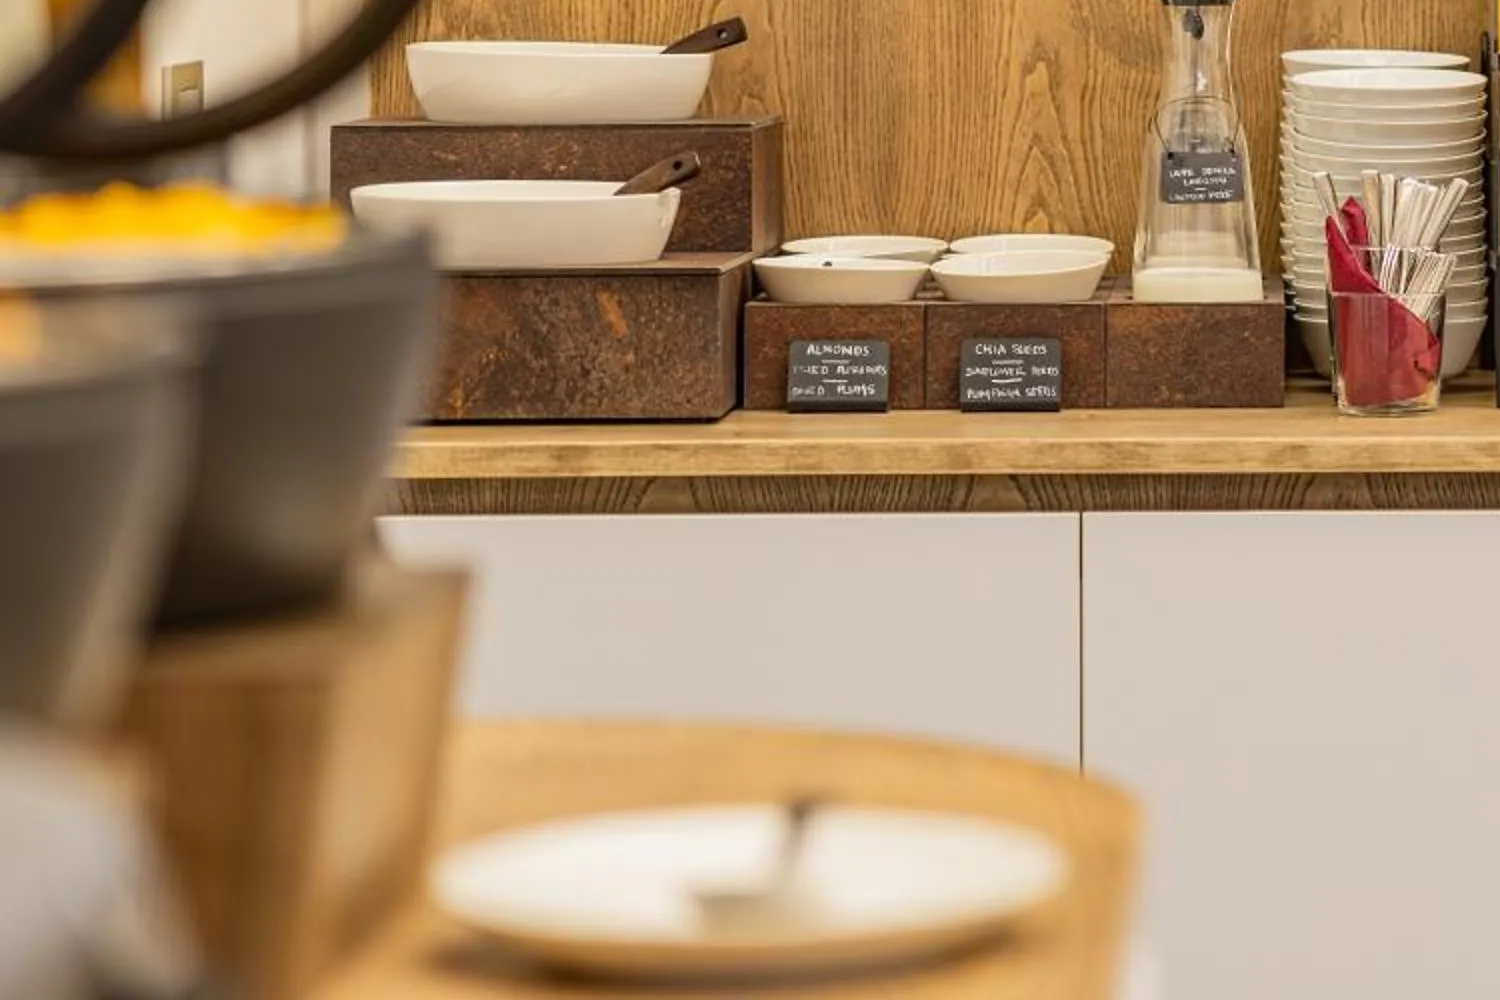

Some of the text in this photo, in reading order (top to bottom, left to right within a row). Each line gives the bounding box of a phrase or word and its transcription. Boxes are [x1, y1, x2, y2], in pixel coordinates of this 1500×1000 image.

[806, 343, 871, 356] ALMONDS
[975, 343, 1048, 355] CHIA SEEDS
[837, 383, 876, 397] PLUMS
